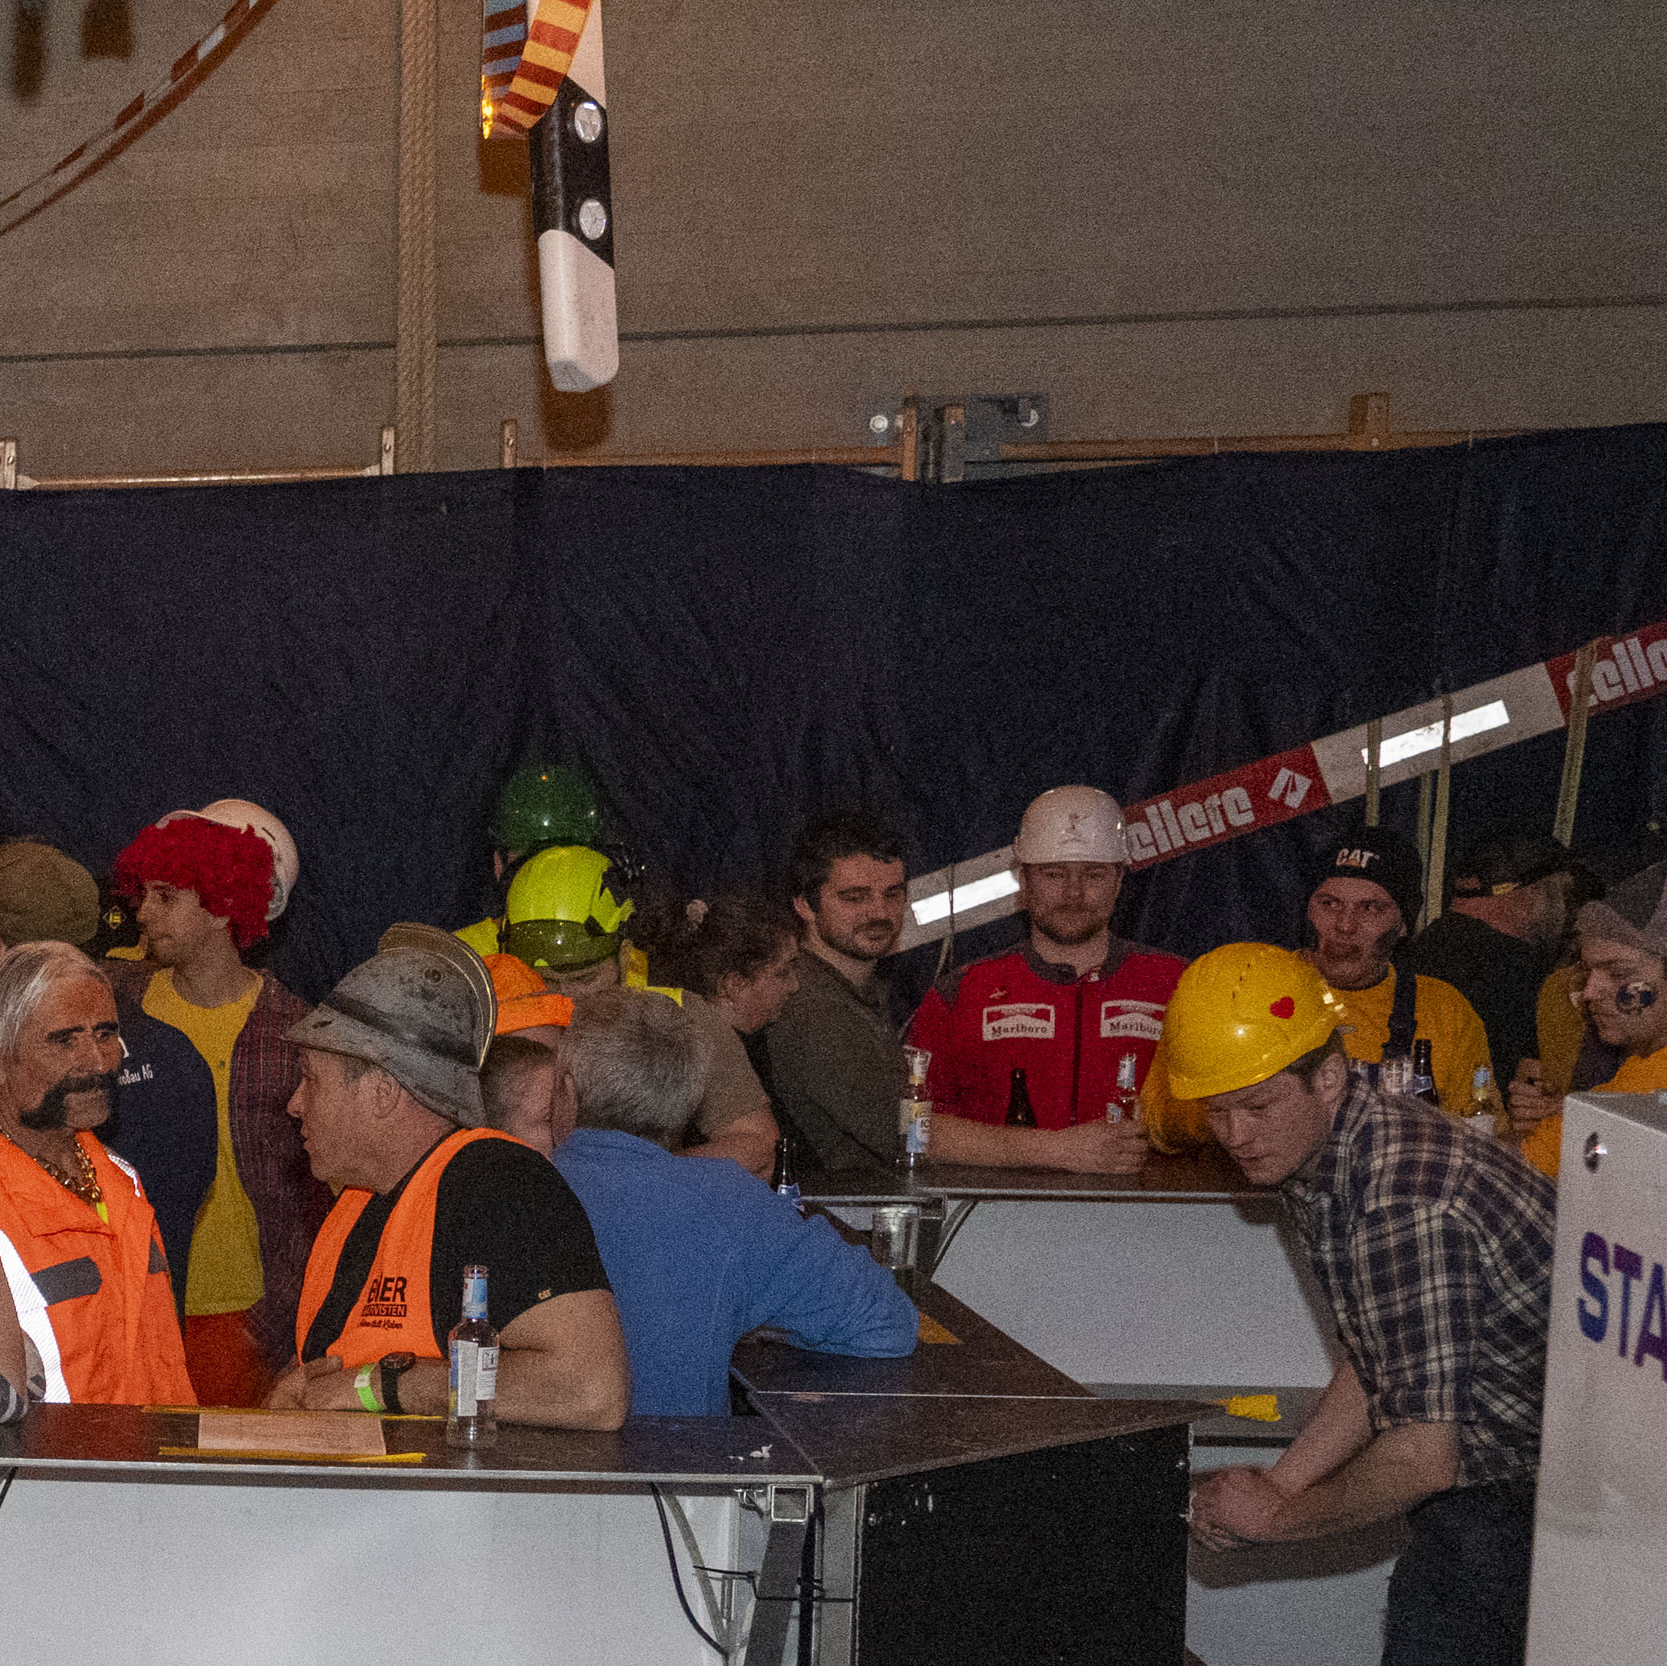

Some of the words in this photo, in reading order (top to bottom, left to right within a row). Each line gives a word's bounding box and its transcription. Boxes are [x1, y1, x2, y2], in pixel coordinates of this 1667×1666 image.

[1125, 786, 1255, 863] ellere
[1335, 848, 1374, 868] CAT
[991, 1023, 1048, 1036] Marlboro
